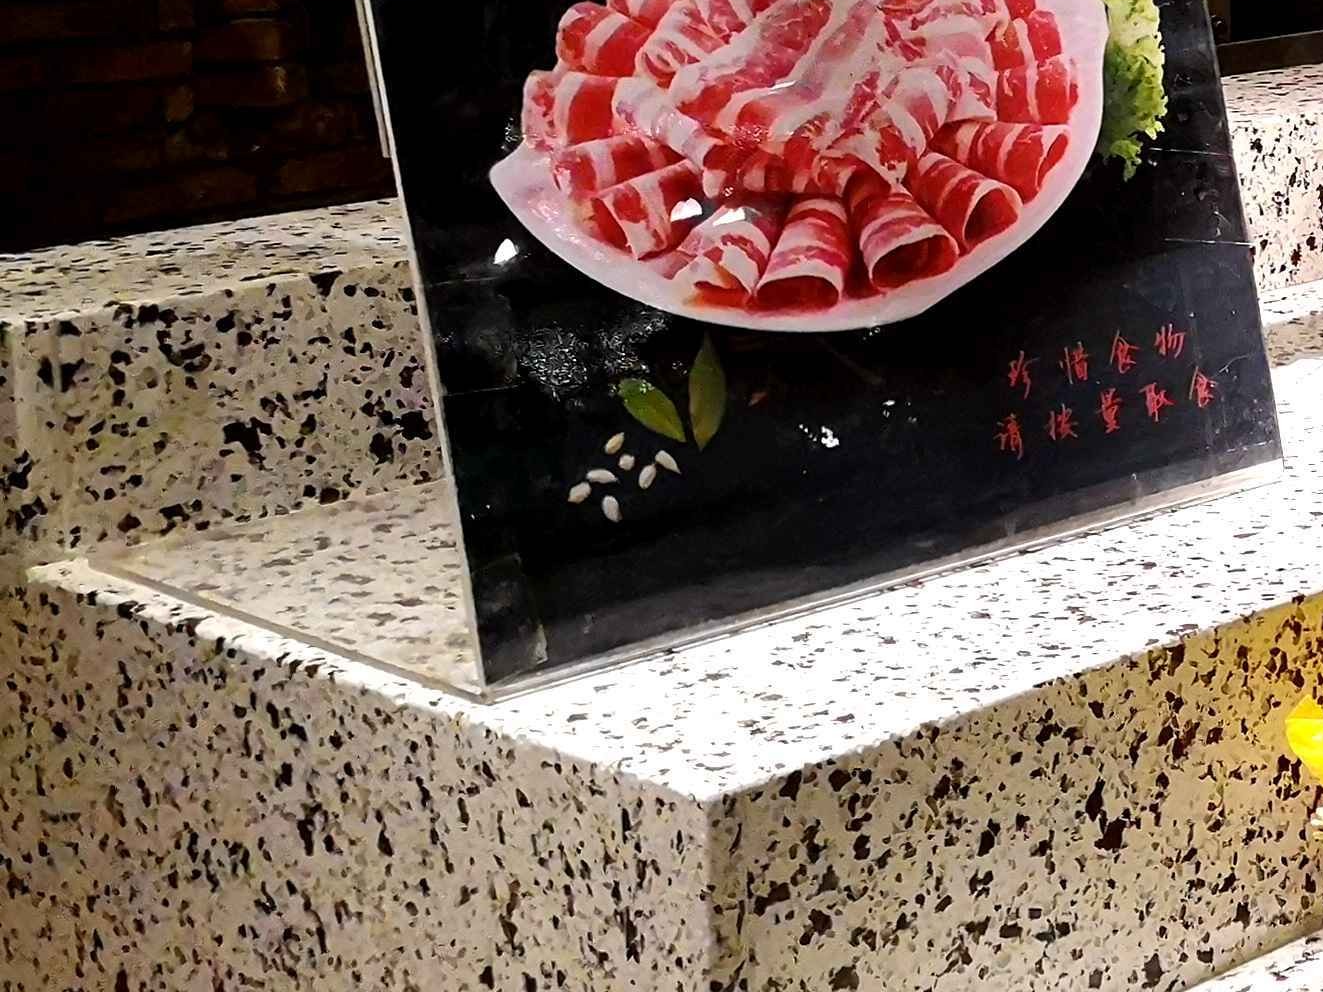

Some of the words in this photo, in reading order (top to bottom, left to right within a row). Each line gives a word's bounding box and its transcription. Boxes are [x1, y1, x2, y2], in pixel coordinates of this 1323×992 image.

[1007, 323, 1187, 400] 珍惜食物
[995, 365, 1220, 460] 请按量取食
